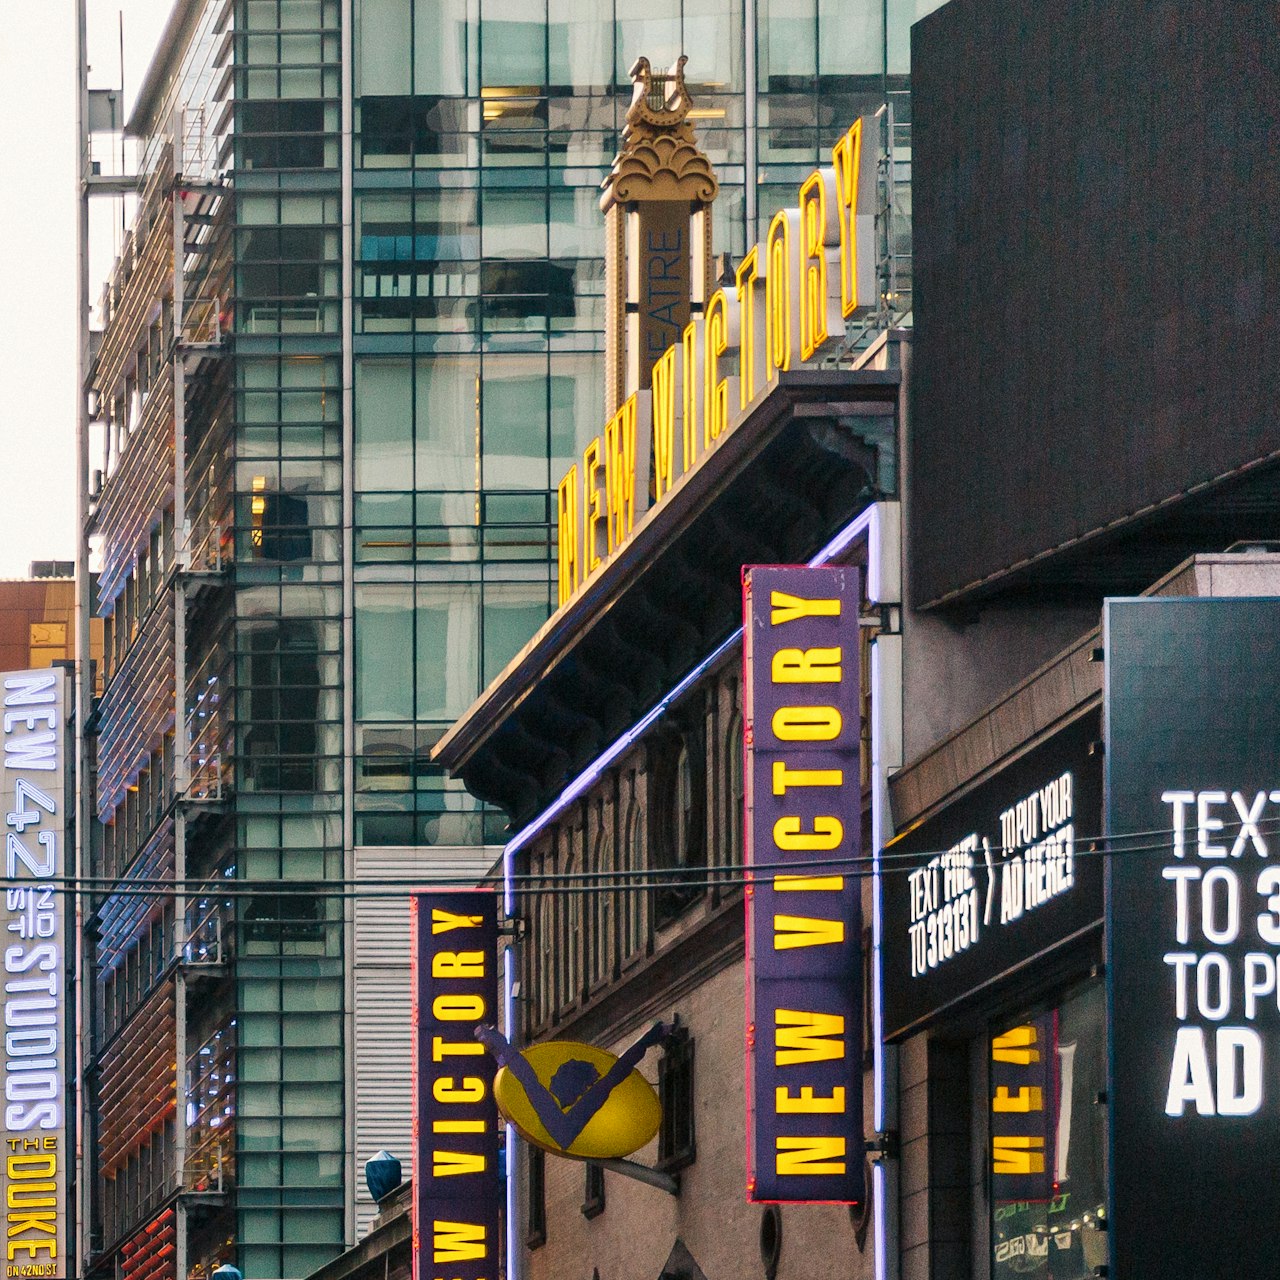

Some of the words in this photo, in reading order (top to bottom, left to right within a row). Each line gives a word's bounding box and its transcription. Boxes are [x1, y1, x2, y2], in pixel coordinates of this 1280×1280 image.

[557, 389, 638, 610] NEW
[651, 116, 864, 504] VICTORY
[3, 676, 56, 770] NEW
[770, 590, 845, 951] VICTORY
[999, 806, 1016, 857] TO
[1016, 791, 1039, 848] PUT
[1039, 770, 1073, 833] YOUR
[907, 856, 939, 923] TEXT
[1001, 856, 1024, 925] AD
[1025, 824, 1075, 911] HERE!
[1162, 866, 1239, 945] TO
[908, 921, 927, 978] TO
[927, 888, 979, 969] 313131
[1163, 952, 1231, 1021] TO
[4, 945, 58, 1130] STUDIOS
[431, 908, 486, 1177] VICTORY
[1165, 1026, 1263, 1117] AD
[775, 1007, 846, 1176] NEW
[6, 1138, 56, 1150] THE
[6, 1154, 57, 1262] DUKE
[6, 1265, 20, 1278] ON
[22, 1264, 45, 1277] 42ND
[46, 1263, 57, 1276] ST
